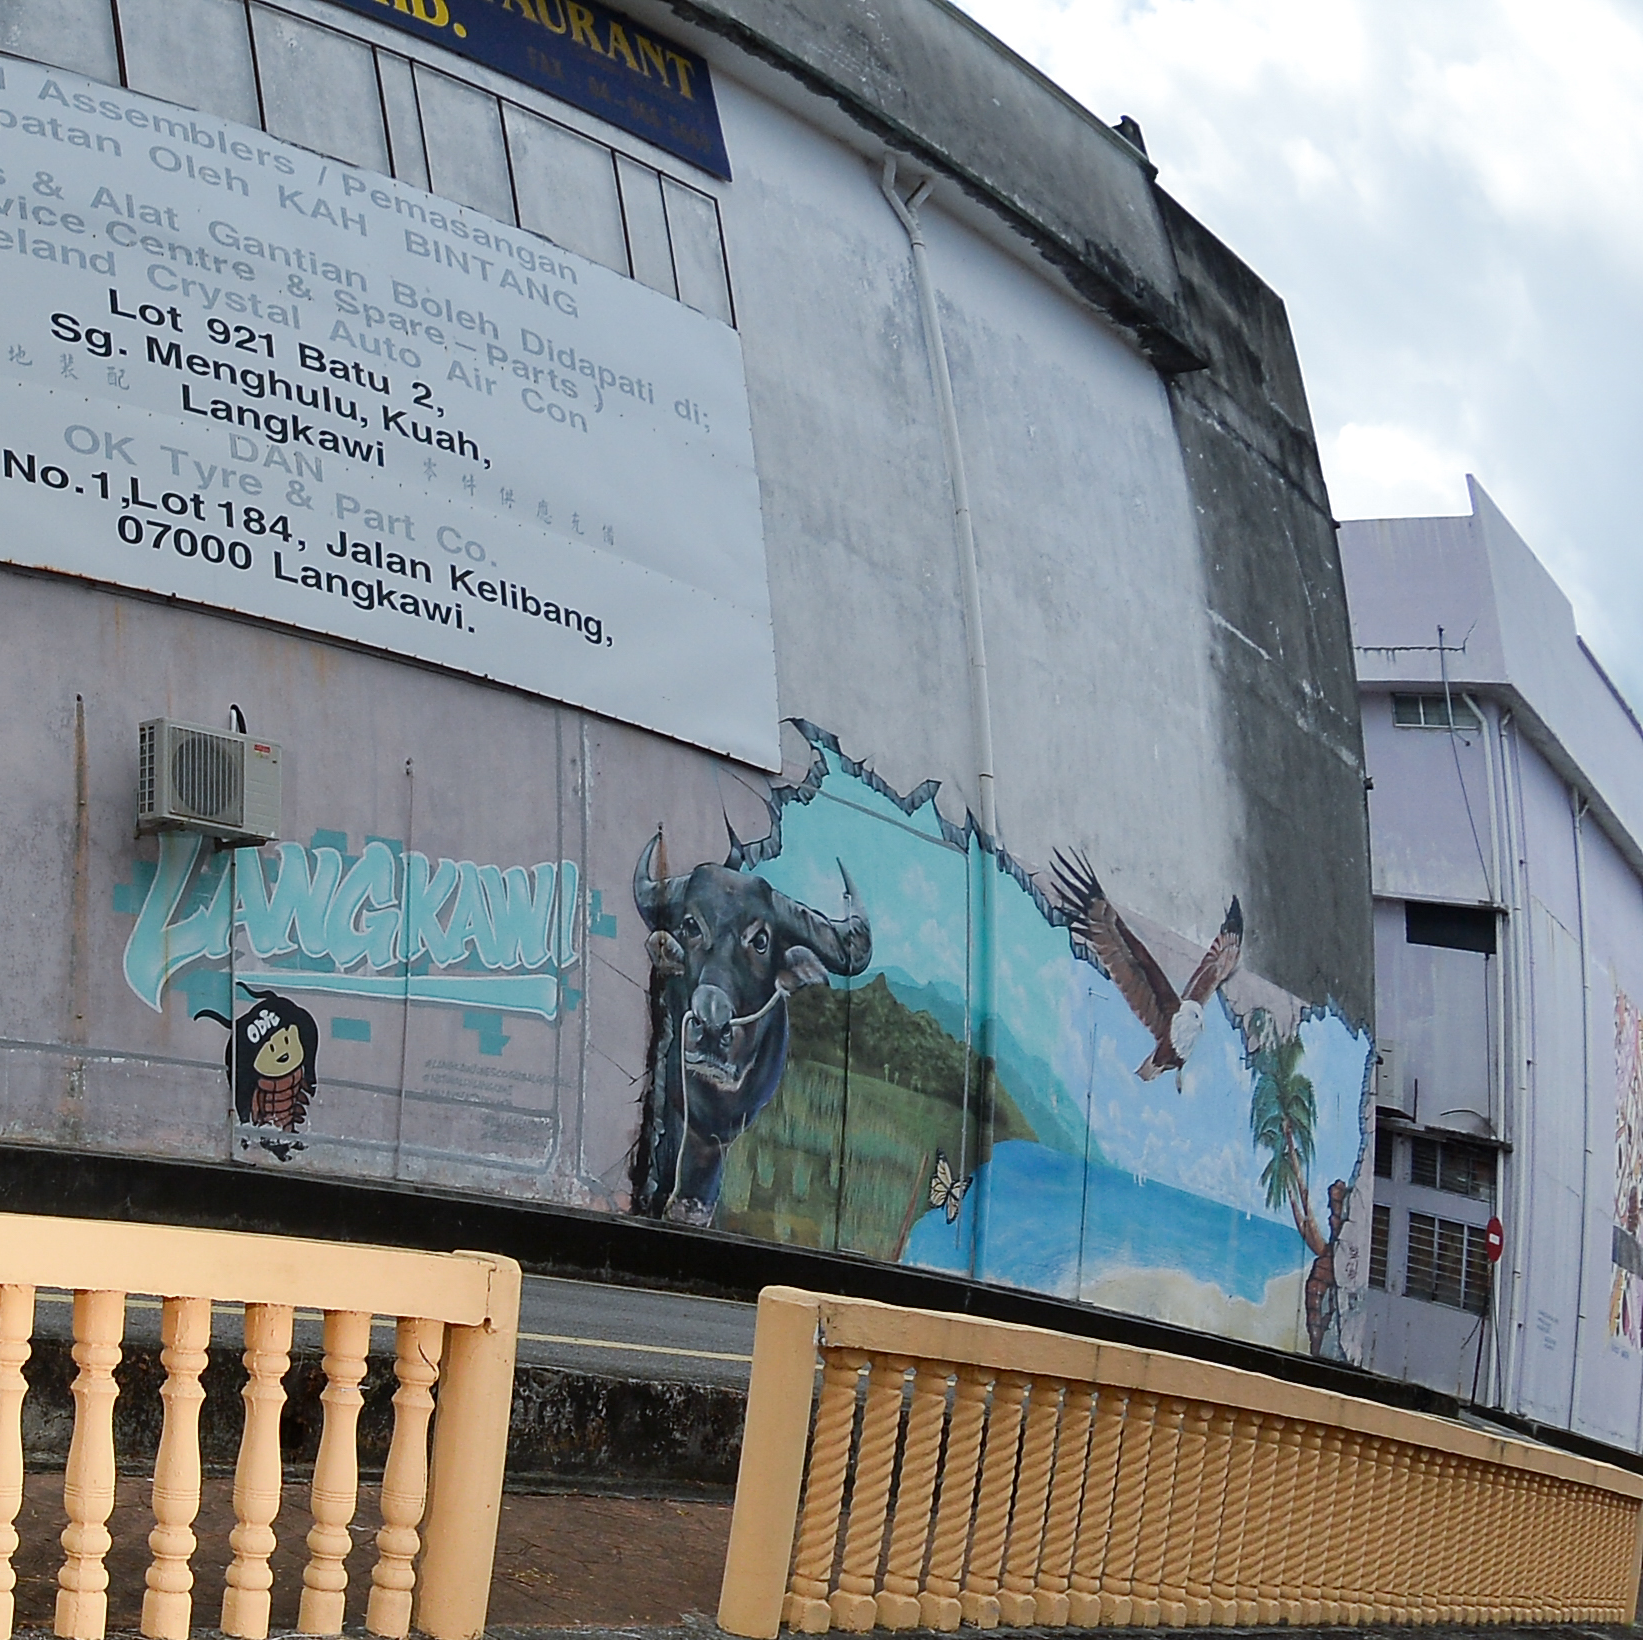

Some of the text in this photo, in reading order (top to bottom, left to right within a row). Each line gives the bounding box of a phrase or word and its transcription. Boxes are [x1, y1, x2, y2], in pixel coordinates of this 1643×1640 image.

[486, 0, 695, 100] AURANT
[38, 79, 294, 176] Assemblers
[342, 172, 580, 286] Pemasangan
[149, 146, 250, 197] Oleh
[279, 185, 368, 237] KAH
[405, 230, 580, 318] BINTANG
[31, 170, 64, 199] &
[90, 186, 180, 232] Alat
[208, 220, 368, 293] Gantian
[392, 279, 499, 340] Boleh
[521, 327, 654, 404] Didapati
[105, 220, 256, 281] Centre
[287, 273, 313, 299] &
[50, 312, 493, 471] Sg. Menghulu, Kuah,
[108, 288, 446, 418] Lot 921 Batu 2,
[147, 263, 301, 330] Crystal
[330, 319, 423, 369] Auto
[446, 359, 498, 396] Air
[521, 386, 589, 433] Con
[64, 424, 500, 567] OK Tyre & Part Co.
[181, 384, 386, 469] Langkawi
[229, 433, 325, 483] DAN
[117, 516, 478, 636] 07000 Langkawi.
[221, 501, 307, 553] 184,
[326, 529, 433, 584] Jalan
[450, 564, 616, 649] Kelibang,
[122, 832, 582, 1013] LANGKAWI
